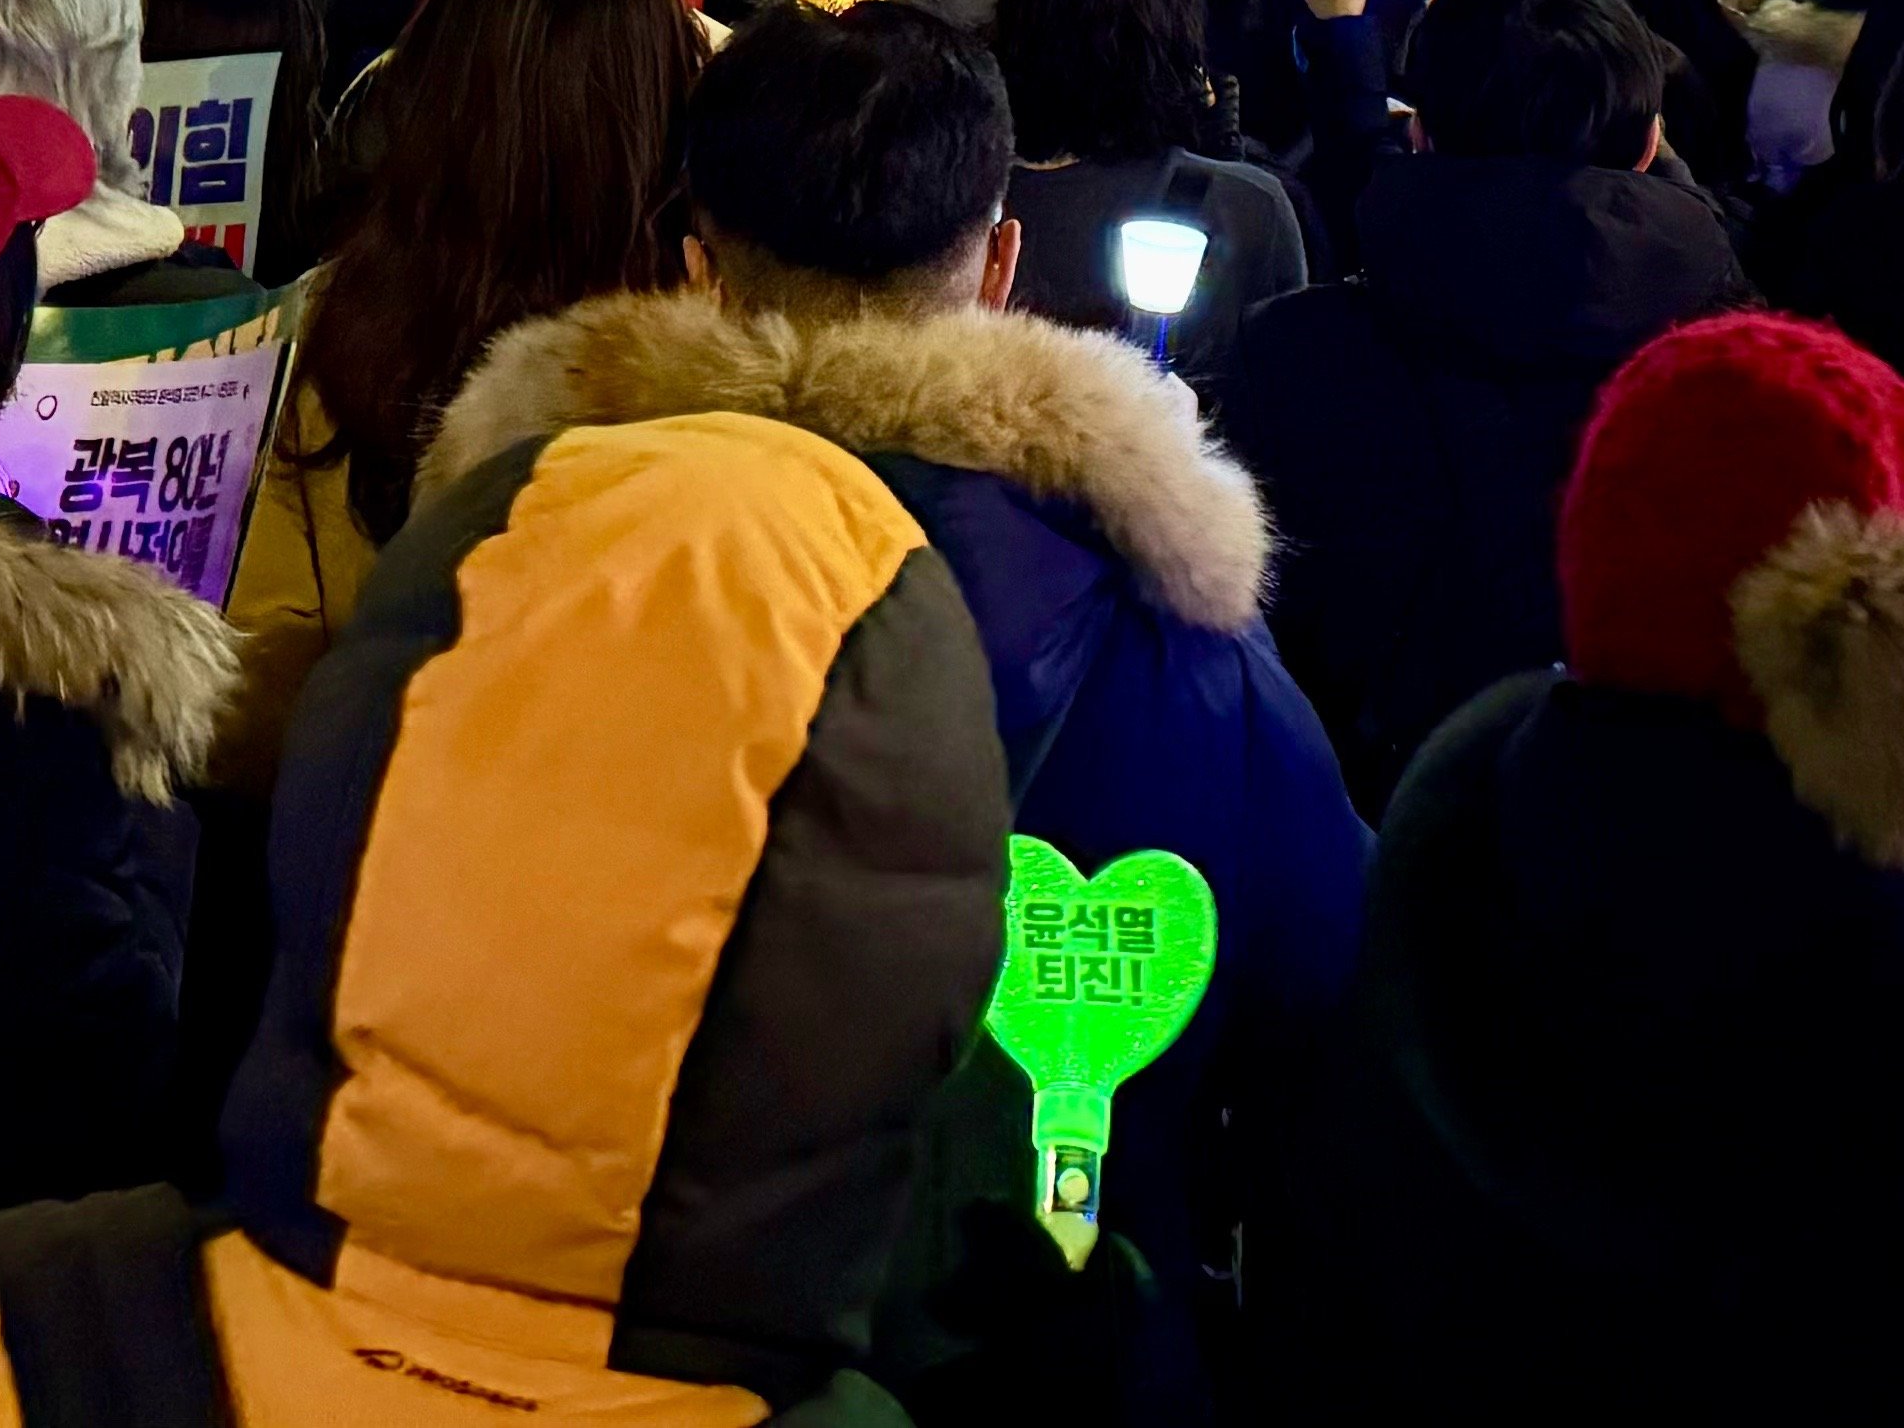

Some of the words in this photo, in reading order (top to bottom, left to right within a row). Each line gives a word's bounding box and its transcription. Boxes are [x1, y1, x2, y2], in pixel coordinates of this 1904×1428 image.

[59, 436, 158, 513] 광복
[158, 430, 232, 513] 80년
[1023, 901, 1157, 955] 윤석열
[1035, 954, 1144, 1008] 퇴진!
